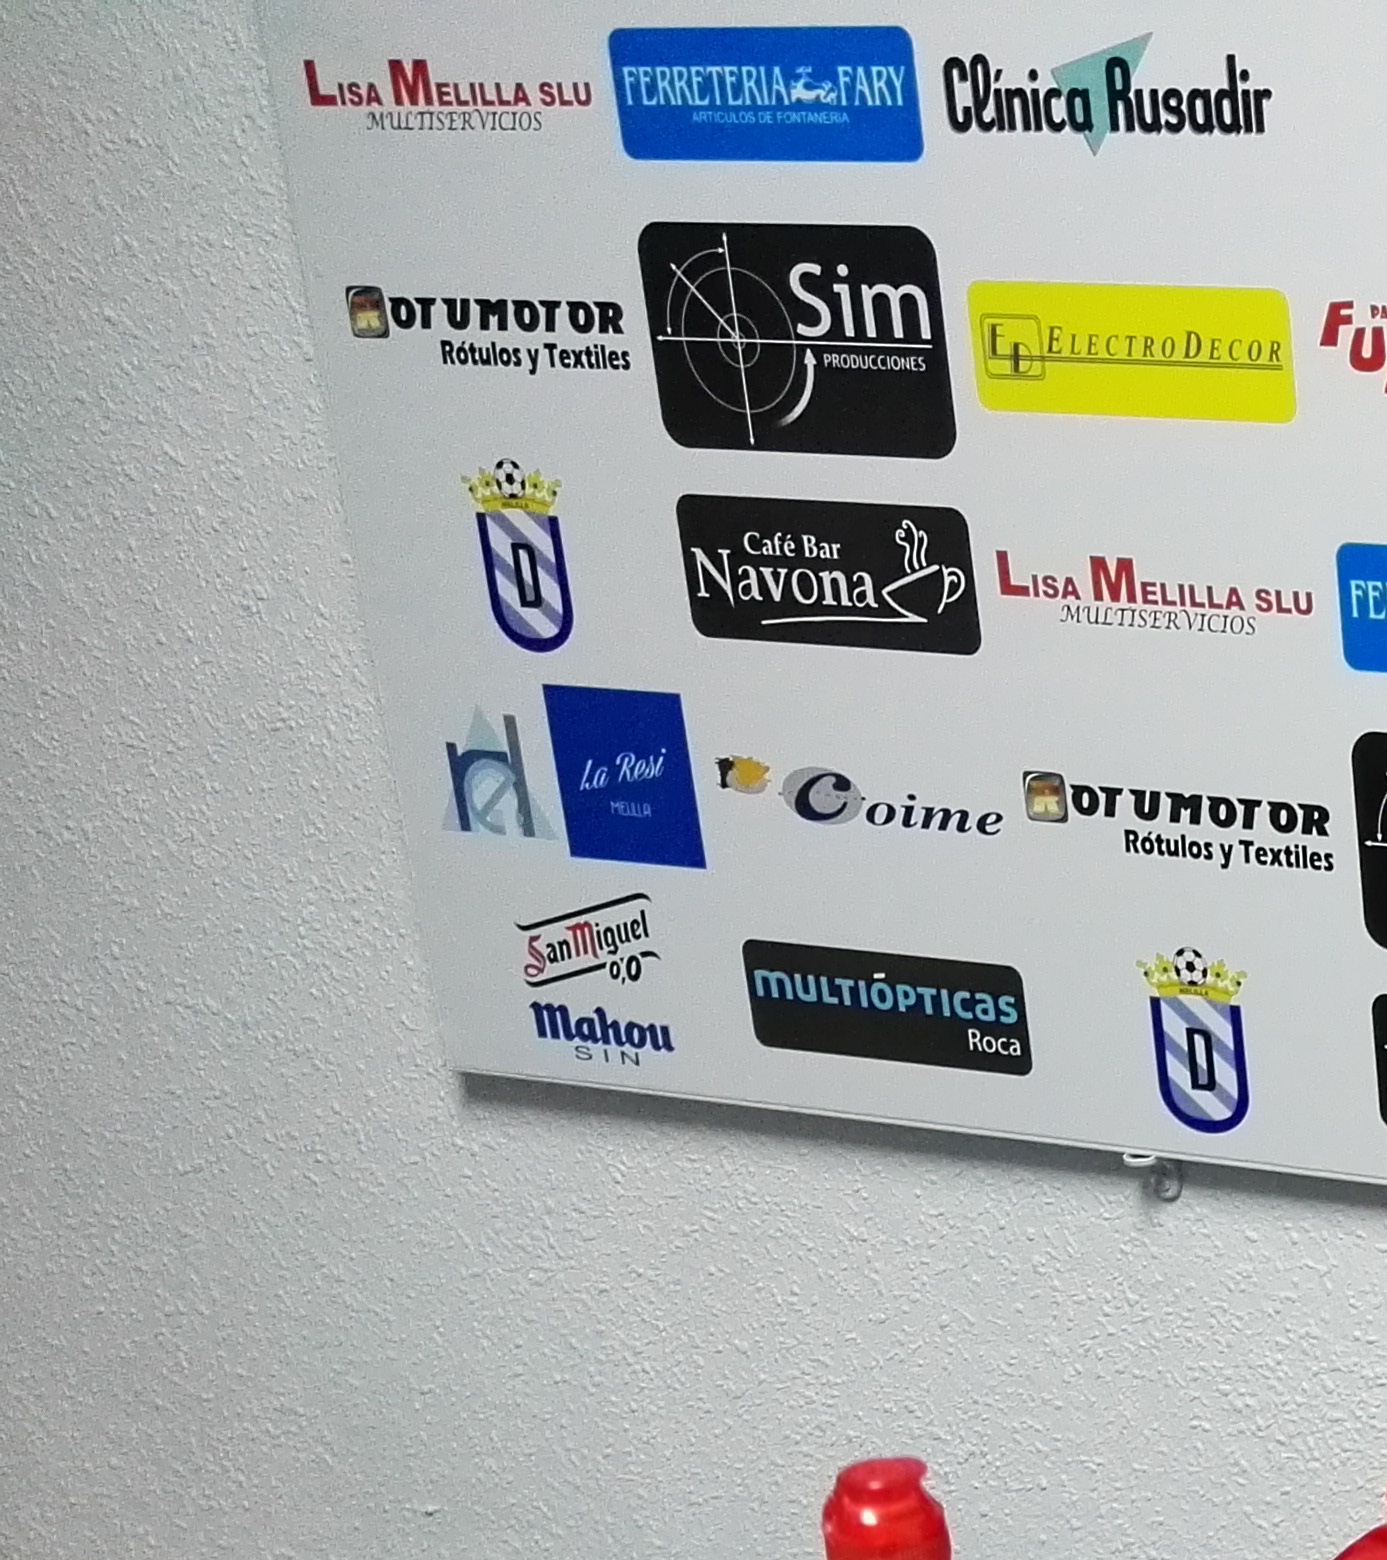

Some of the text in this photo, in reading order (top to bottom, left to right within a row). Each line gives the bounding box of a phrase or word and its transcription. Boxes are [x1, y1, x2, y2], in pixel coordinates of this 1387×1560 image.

[303, 58, 593, 108] LISA MELILLA SLU
[622, 64, 906, 109] FERRETERIA FARY
[943, 53, 1273, 136] Clínica Rusadir
[365, 109, 544, 133] MULTISERVICIOS
[692, 110, 758, 126] ARTICULOS
[760, 111, 775, 125] DE
[787, 262, 933, 343] Sim
[440, 339, 631, 376] Rótulos y Textiles
[822, 352, 927, 374] PRODUCCIONES
[742, 529, 841, 560] Café Bar
[690, 546, 879, 609] Navona
[995, 550, 1315, 617] LISA MELILLA SLU
[1060, 604, 1257, 637] MULTISERVICIOS
[579, 747, 667, 792] La Resi
[798, 771, 1004, 836] Coime
[1123, 829, 1335, 874] Rótulos y Textiles
[529, 1000, 675, 1053] Mahou
[967, 1029, 1022, 1058] Roca
[574, 1045, 640, 1067] SIN
